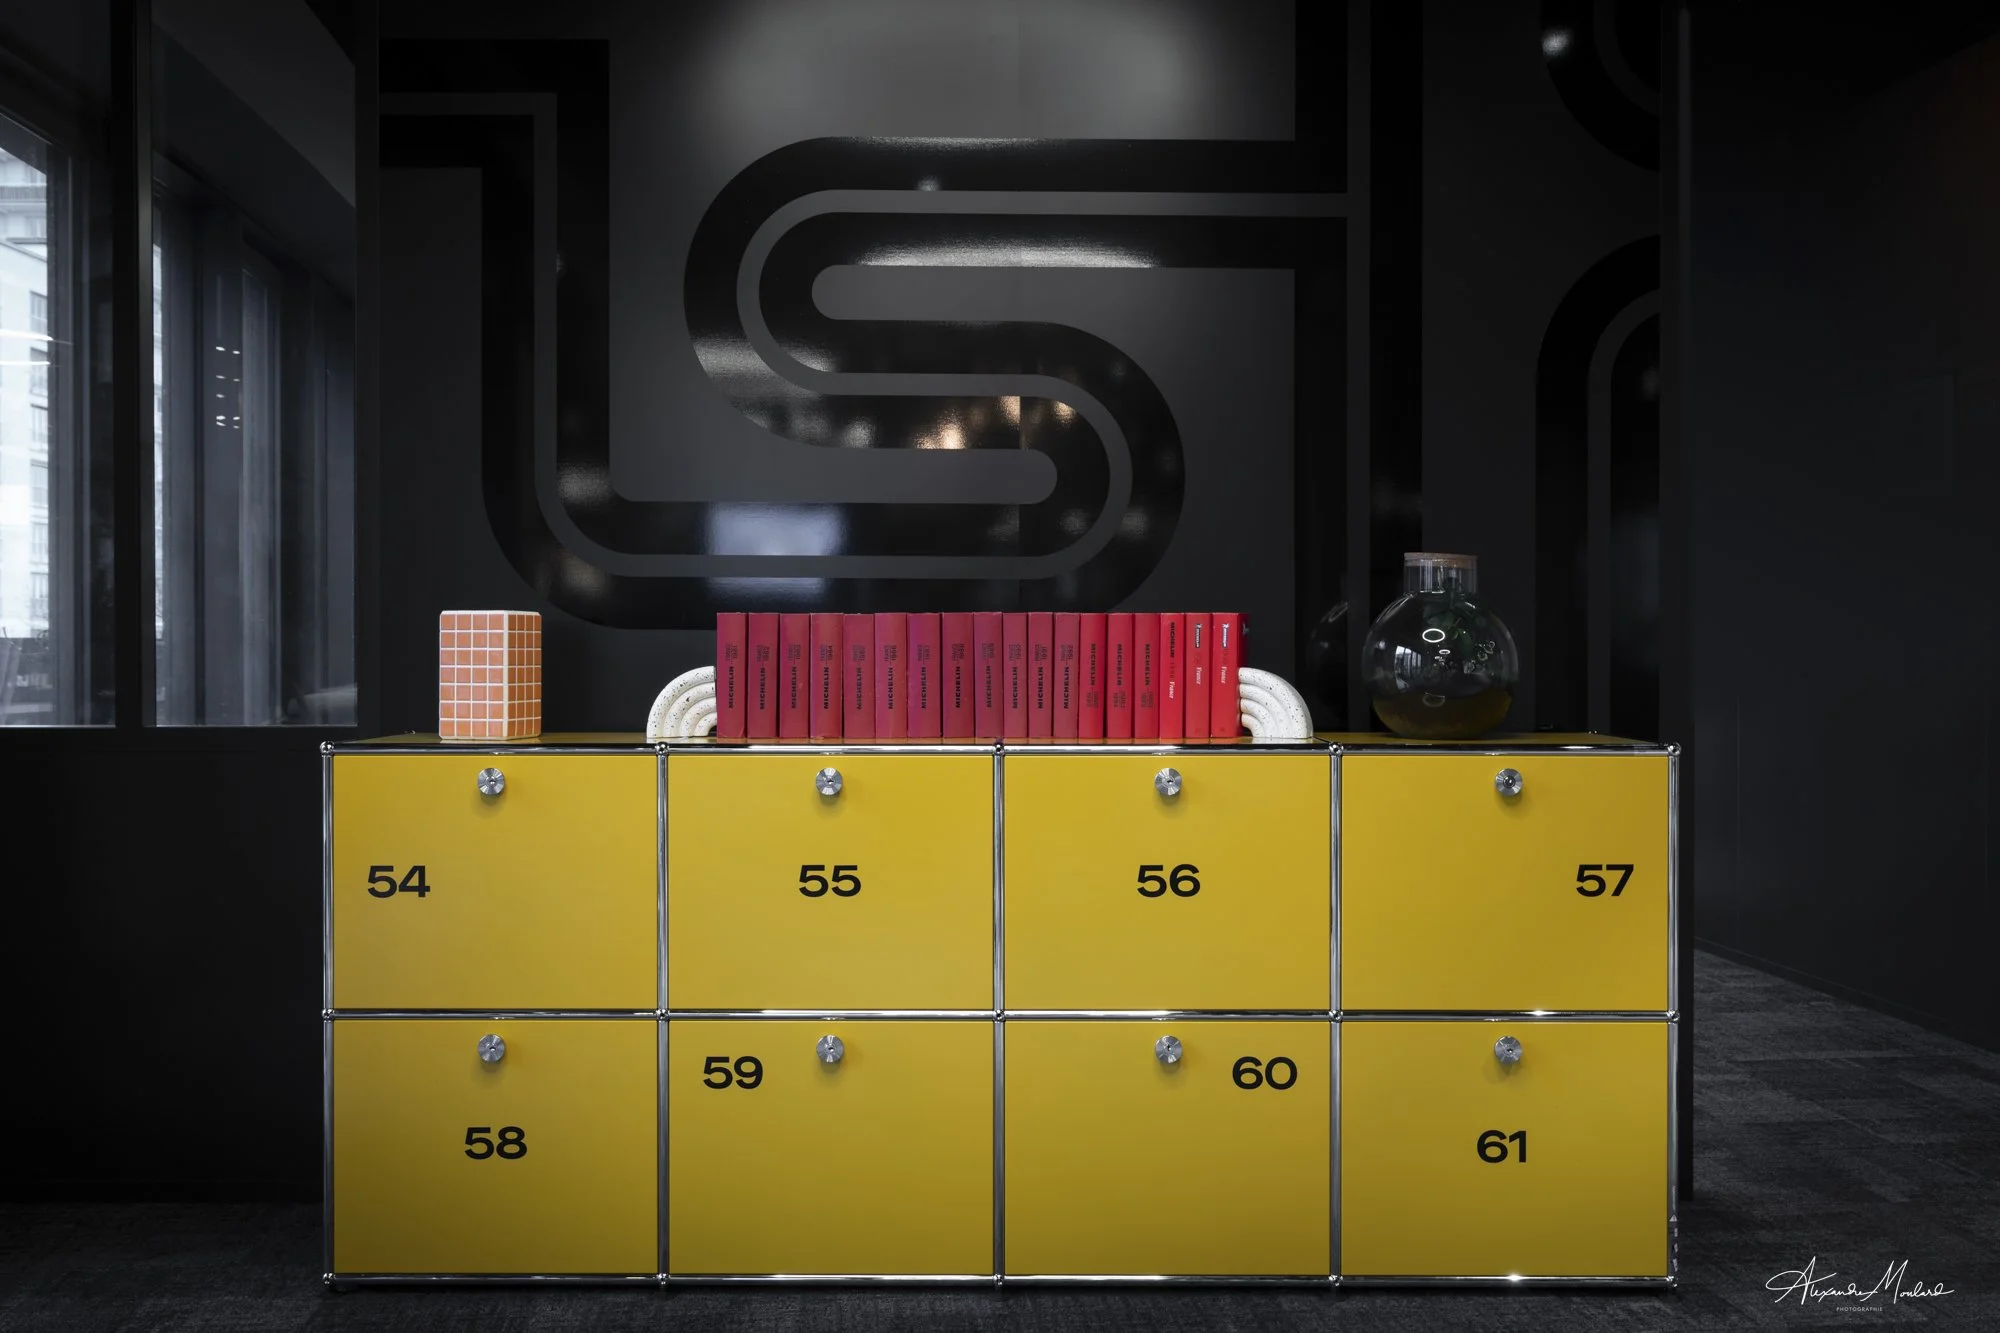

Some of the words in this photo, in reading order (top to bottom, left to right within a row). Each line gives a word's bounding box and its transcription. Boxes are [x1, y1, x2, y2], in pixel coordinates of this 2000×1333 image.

[367, 865, 431, 898] 54
[798, 864, 862, 898] 55
[1136, 863, 1201, 898] 56
[1576, 863, 1634, 898] 57
[703, 1056, 764, 1090] 59
[1231, 1056, 1298, 1091] 60
[464, 1126, 528, 1160] 58
[1476, 1130, 1528, 1164] 61
